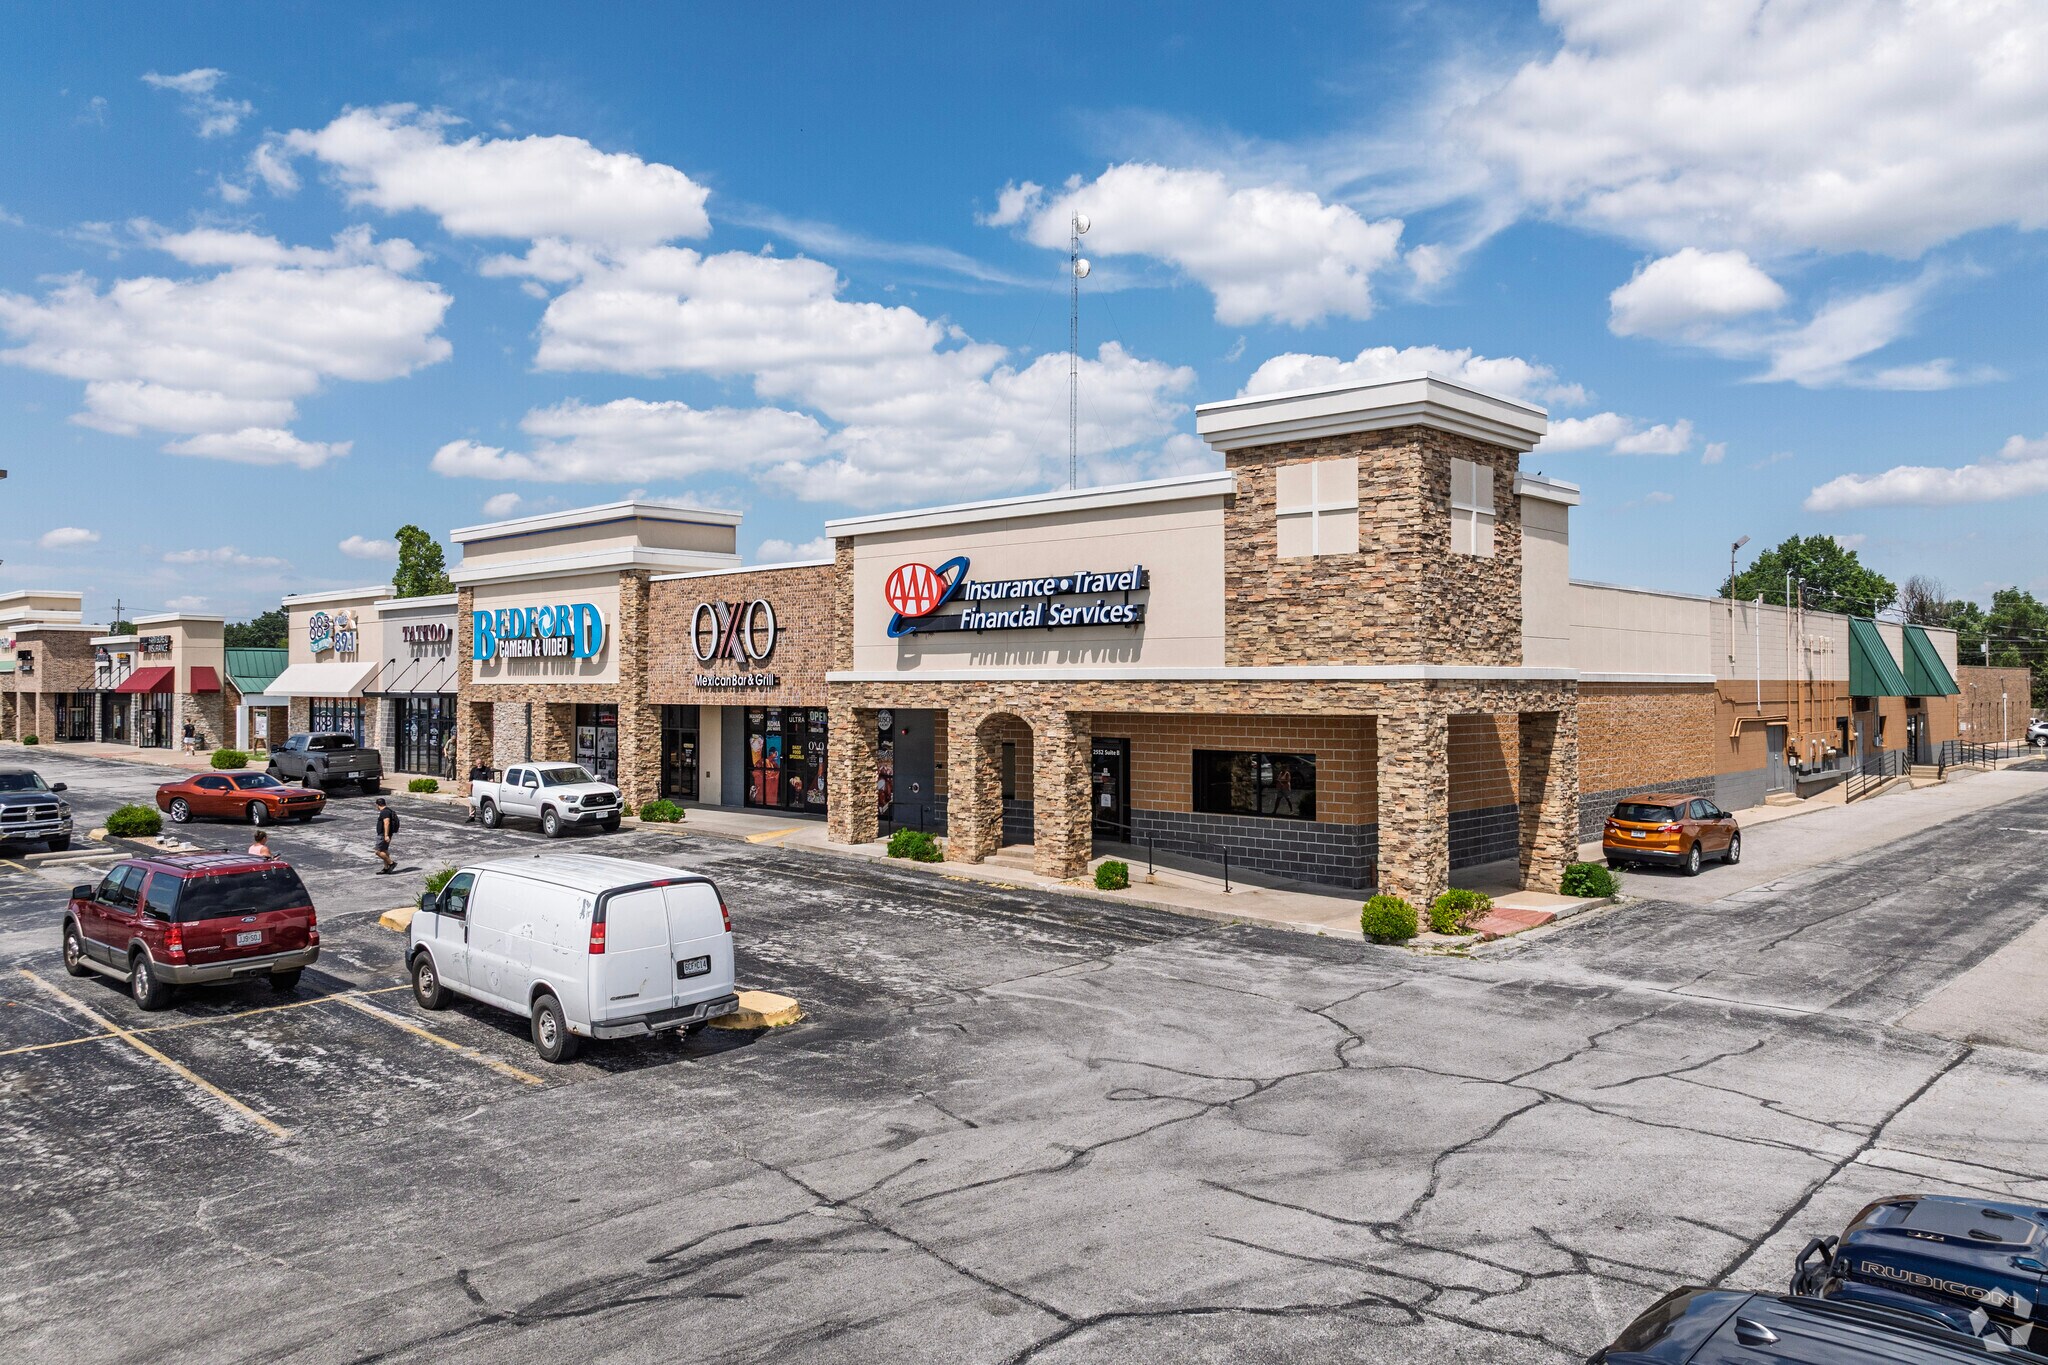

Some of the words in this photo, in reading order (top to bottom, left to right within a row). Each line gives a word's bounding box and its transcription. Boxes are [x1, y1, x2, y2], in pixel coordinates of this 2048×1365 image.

[887, 564, 942, 616] AAA
[965, 577, 1055, 600] Insurance
[1073, 565, 1140, 593] Travel
[309, 615, 330, 641] 88.3
[960, 603, 1044, 629] Financial
[1048, 602, 1136, 626] Services
[335, 632, 354, 652] 89.1
[402, 623, 446, 642] TATTOO
[472, 603, 604, 660] BEDFORD
[691, 599, 775, 662] OXO
[499, 639, 533, 658] CAMERA
[534, 638, 540, 657] &
[542, 637, 568, 656] VIDEO
[695, 674, 731, 686] Mexican
[732, 674, 747, 686] Bar
[747, 673, 754, 686] &
[755, 673, 774, 686] Grill
[1860, 1260, 2019, 1309] RUBICON
